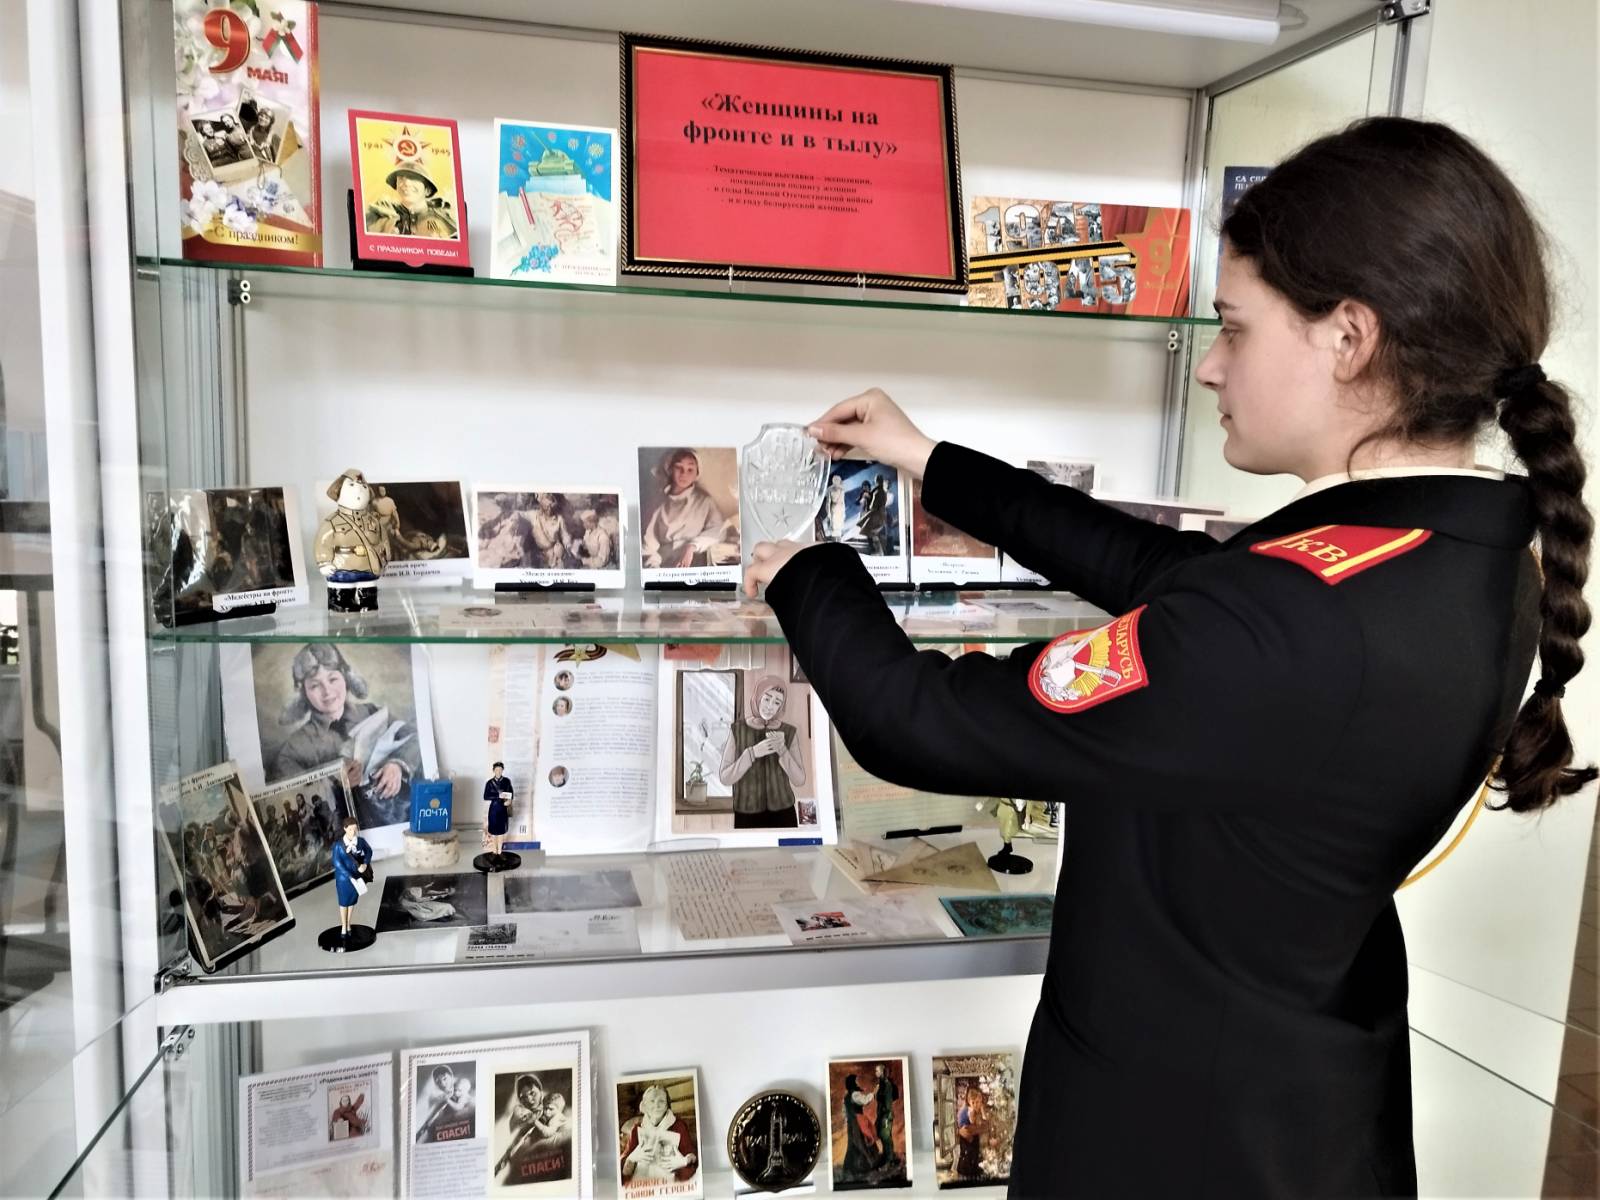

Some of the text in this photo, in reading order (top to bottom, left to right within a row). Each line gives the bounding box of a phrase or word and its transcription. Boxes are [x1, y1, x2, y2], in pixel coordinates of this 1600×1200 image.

[204, 8, 251, 74] 9
[247, 66, 289, 85] МАЯ!
[701, 92, 879, 125] «Женщины на
[683, 120, 898, 160] фронте и в тылу»
[744, 187, 782, 199] Великой
[782, 191, 844, 204] Отечественной
[229, 230, 300, 246] праздником!
[974, 202, 1103, 254] 1941
[368, 244, 459, 258] С ПРАЗДНИКОМ ПОБЕДЫ!
[1149, 240, 1173, 278] 9
[992, 253, 1138, 312] 1945
[1283, 537, 1348, 564] КВ
[418, 807, 449, 818] ПОЧТА
[436, 1123, 471, 1140] СПАСИ!
[520, 1153, 566, 1176] СПАСИ!
